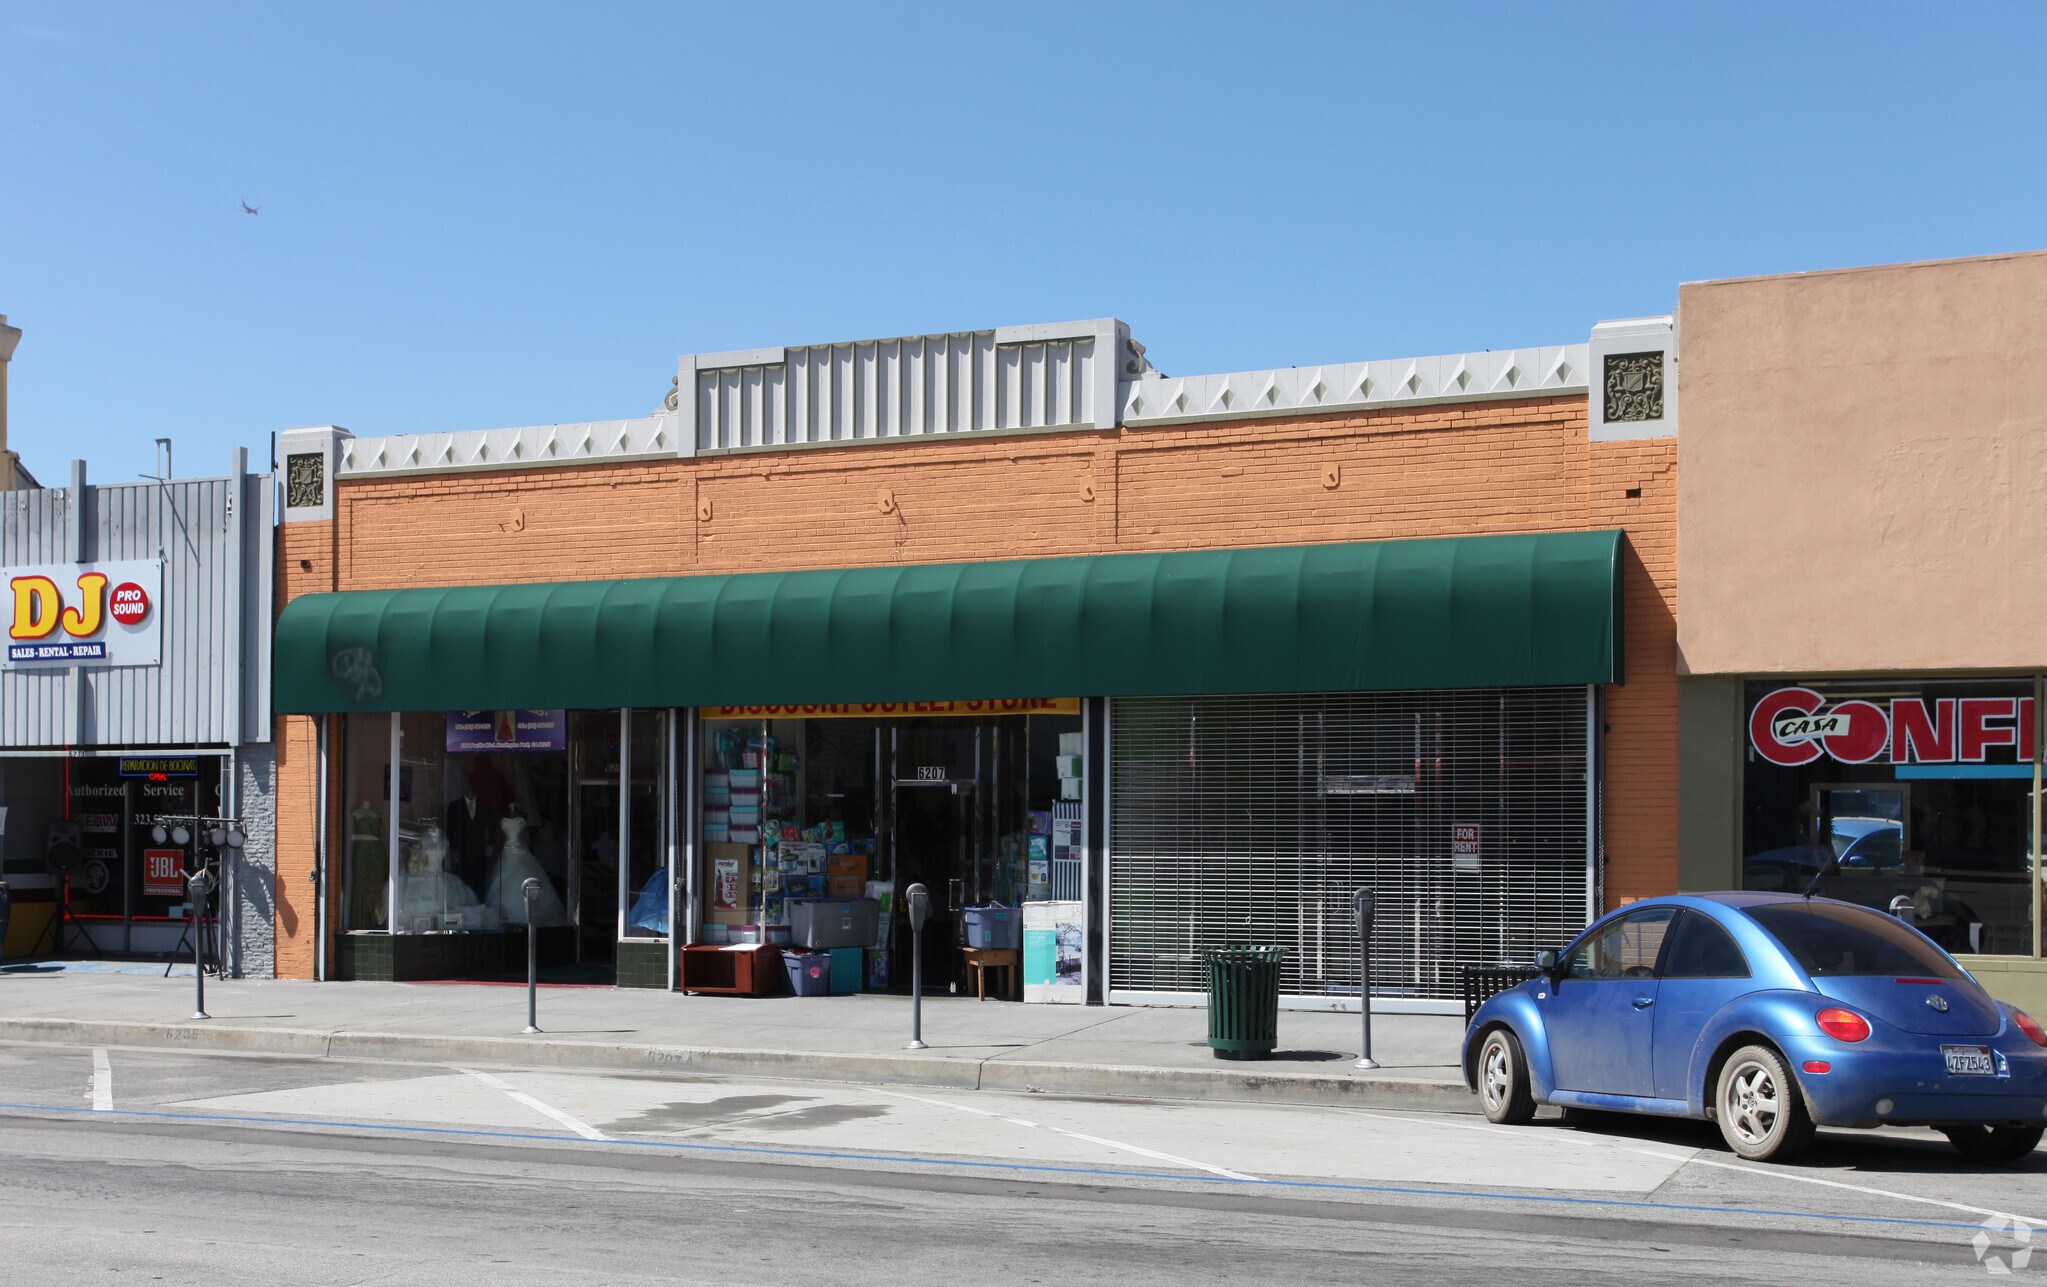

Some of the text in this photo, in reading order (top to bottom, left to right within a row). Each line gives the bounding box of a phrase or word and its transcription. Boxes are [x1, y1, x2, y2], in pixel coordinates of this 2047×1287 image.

[117, 590, 141, 602] PRO
[9, 572, 108, 640] DJ
[113, 602, 144, 616] SOUND
[12, 645, 102, 658] SALES RENTAL REPAIR
[1779, 717, 1838, 738] CASA
[918, 767, 944, 779] 6207
[143, 783, 184, 796] Service
[1456, 828, 1474, 840] FOR
[1455, 841, 1477, 853] RENT
[150, 857, 179, 878] JBL
[1947, 1055, 1991, 1070] 4ZFZ543
